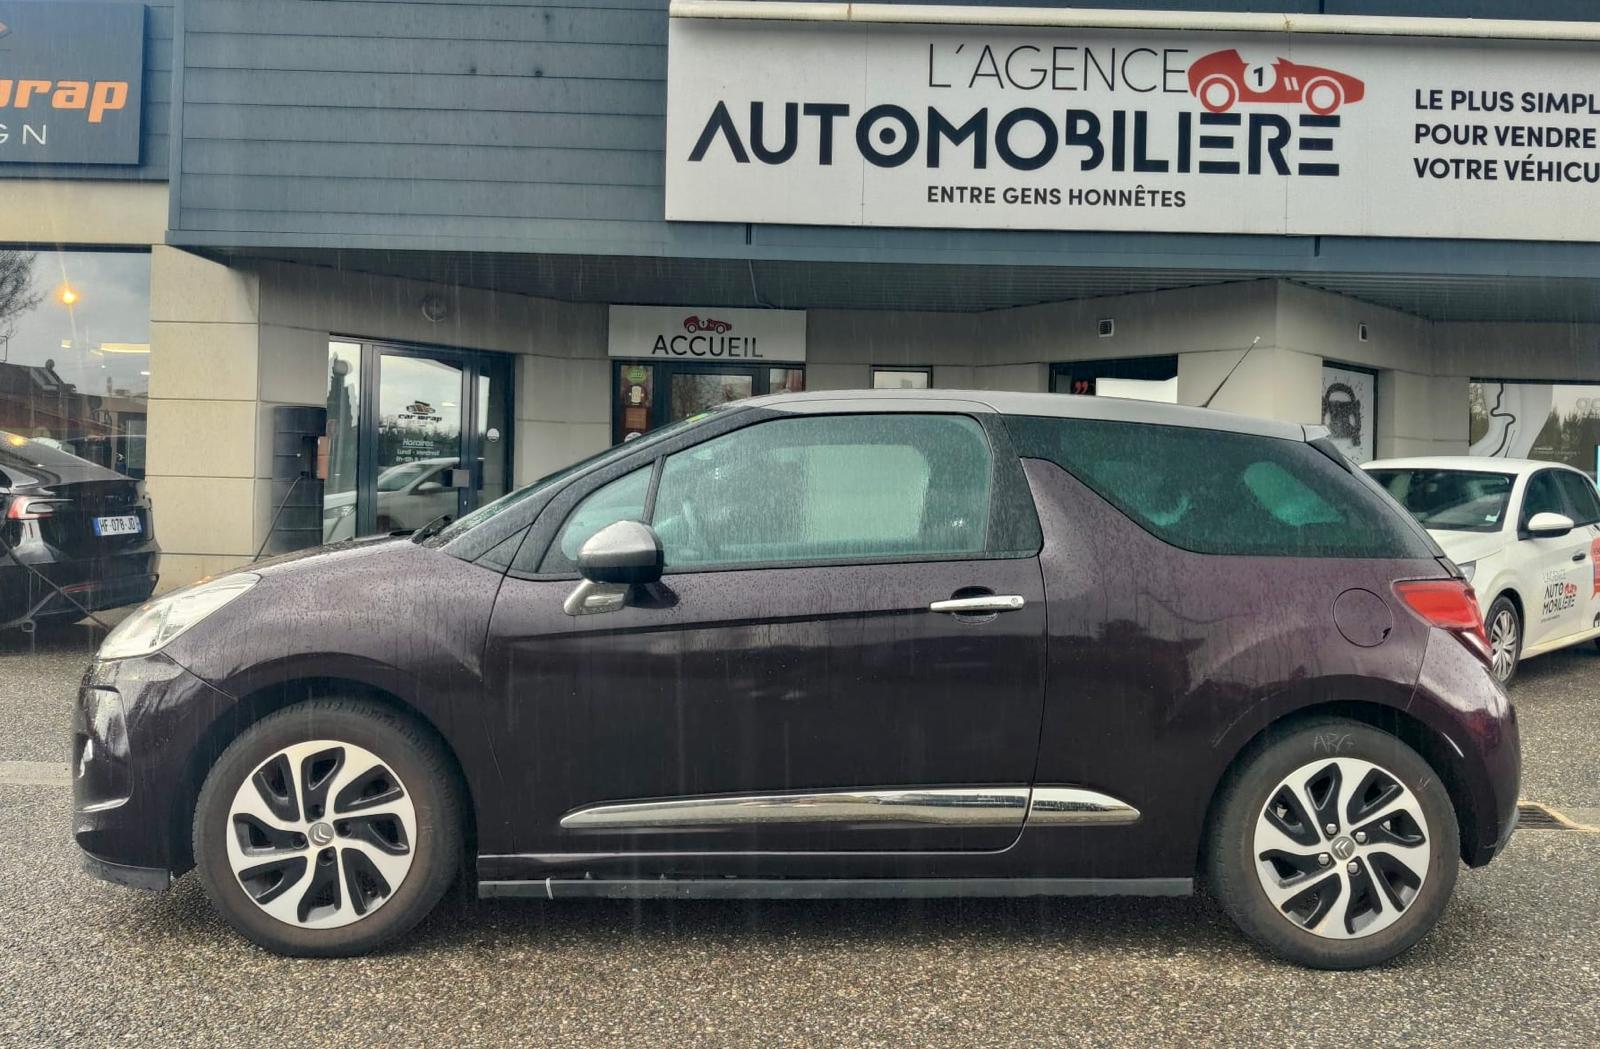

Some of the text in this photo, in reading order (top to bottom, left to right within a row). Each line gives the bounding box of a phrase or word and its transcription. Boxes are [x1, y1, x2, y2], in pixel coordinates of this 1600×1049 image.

[928, 43, 1189, 93] L'AGENCE
[1252, 66, 1265, 87] 1
[1414, 88, 1444, 110] LE
[1451, 90, 1514, 112] PLUS
[687, 100, 1340, 176] AUTOMOBILIERE
[1414, 123, 1597, 149] POUR VENDRE
[1413, 157, 1498, 181] VOTRE
[927, 185, 1187, 208] ENTRE GENS HONNÊTES
[651, 334, 764, 358] ACCUEIL
